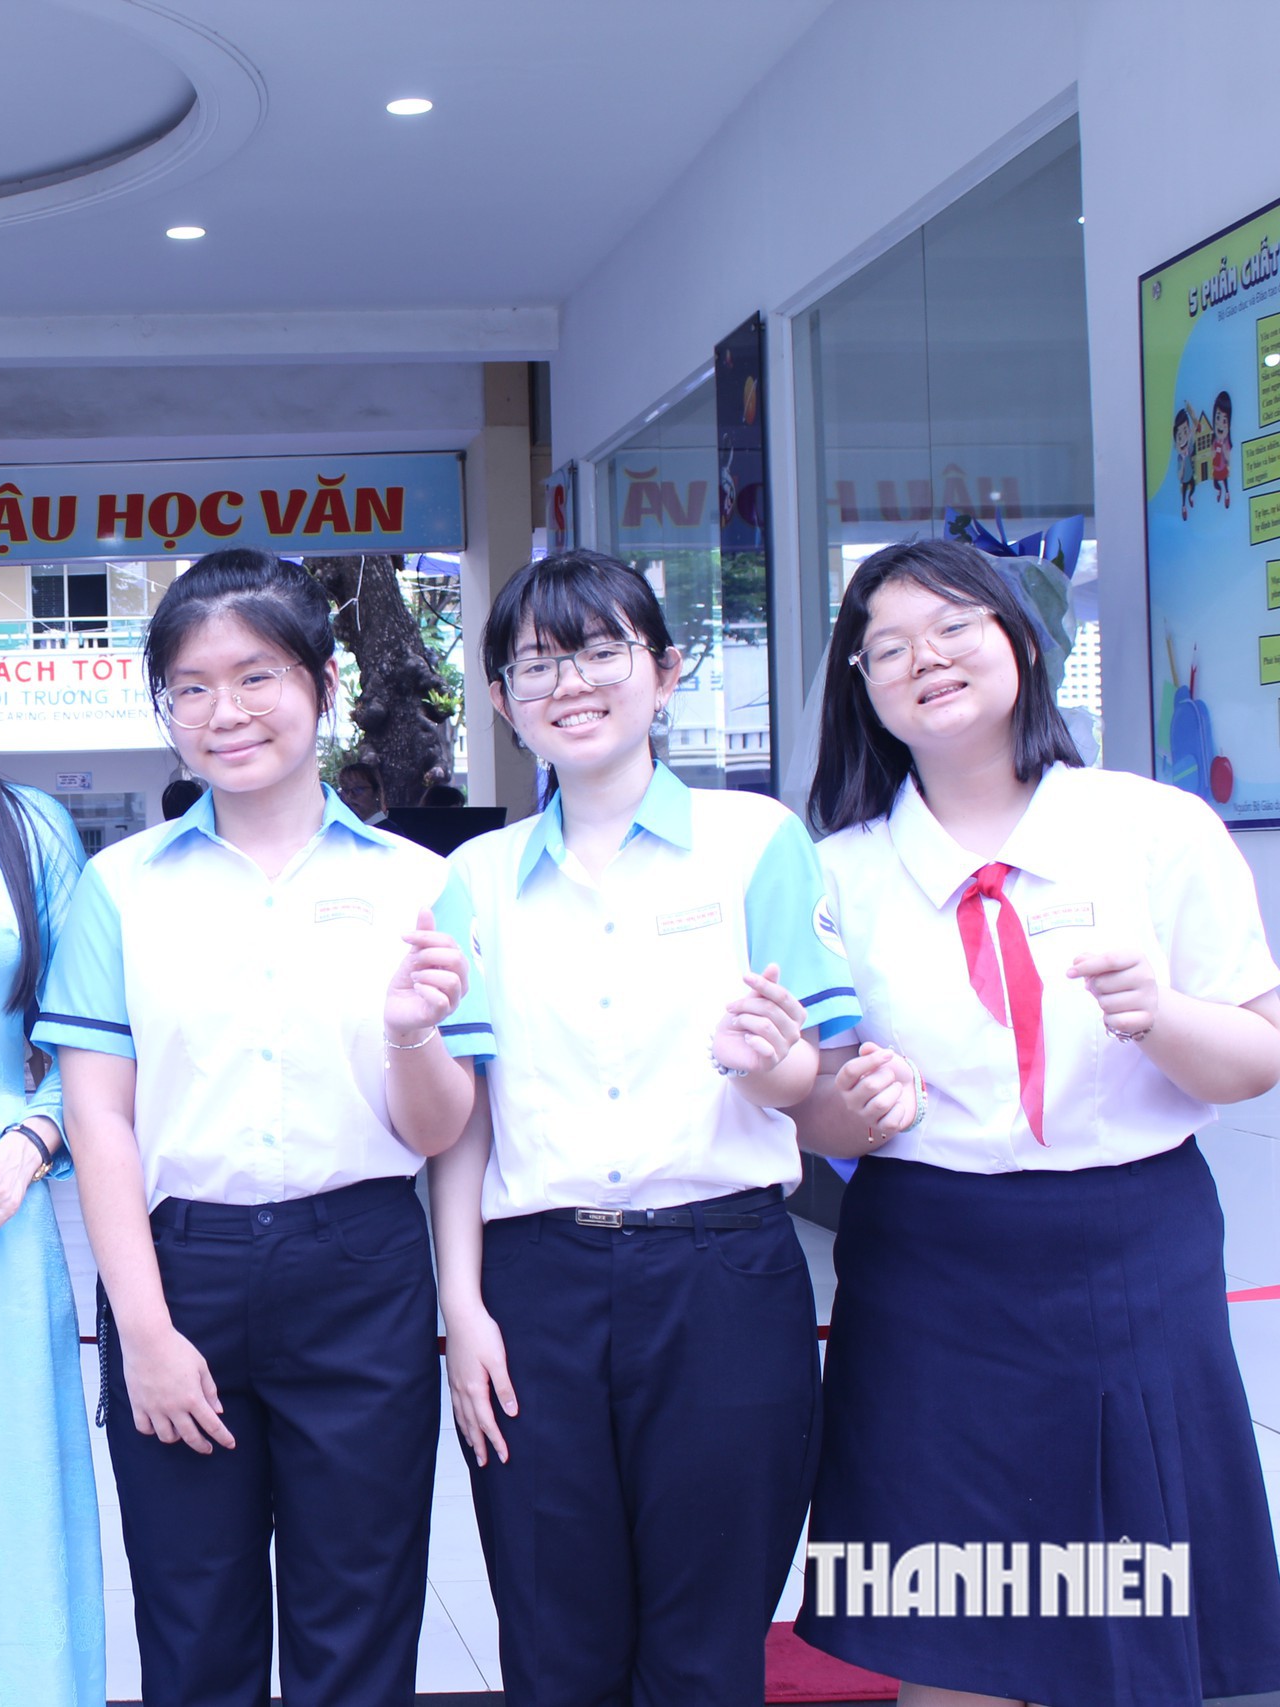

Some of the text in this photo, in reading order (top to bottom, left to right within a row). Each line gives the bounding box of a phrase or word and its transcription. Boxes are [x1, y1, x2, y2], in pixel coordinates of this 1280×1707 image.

[1188, 287, 1198, 317] 5
[96, 490, 244, 550] HỌC
[259, 472, 405, 536] VĂN
[72, 652, 133, 682] TỐT
[22, 686, 109, 706] TRƯỜNG
[121, 688, 147, 704] TH
